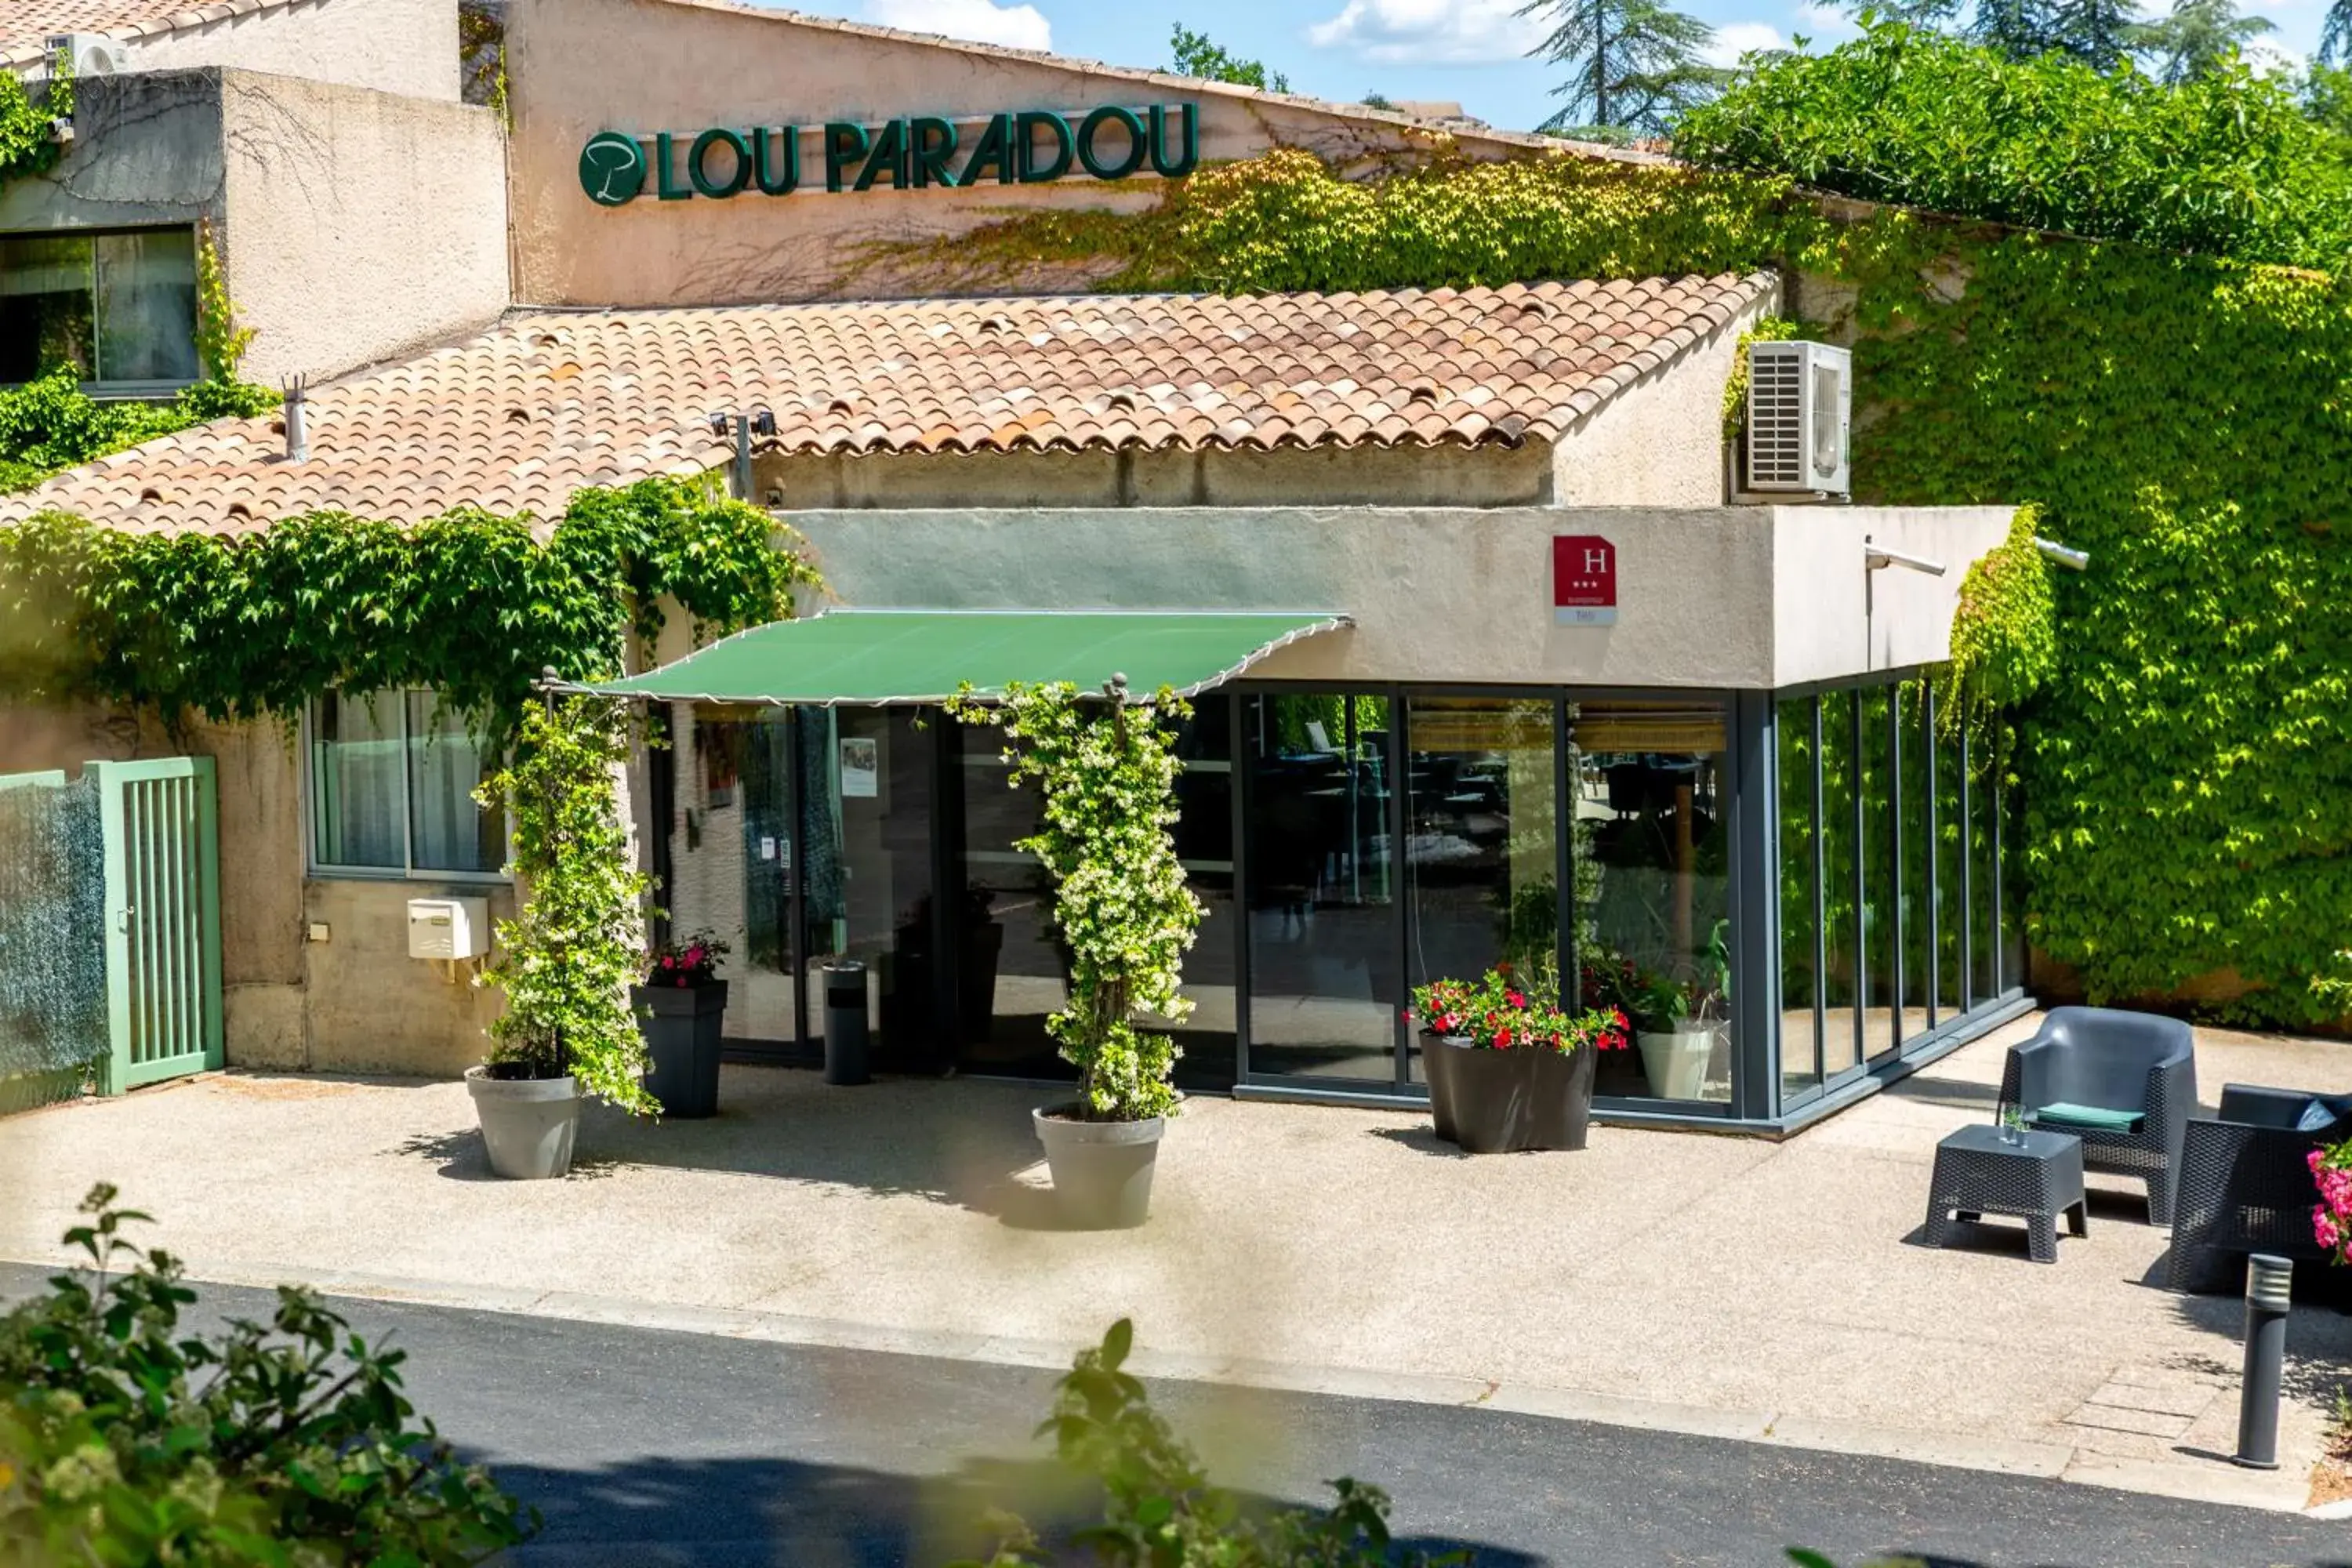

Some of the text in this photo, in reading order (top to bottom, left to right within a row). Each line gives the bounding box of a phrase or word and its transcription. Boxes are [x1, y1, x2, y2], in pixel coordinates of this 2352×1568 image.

[657, 102, 1199, 201] LOU PARADOU
[1584, 549, 1606, 573] H
